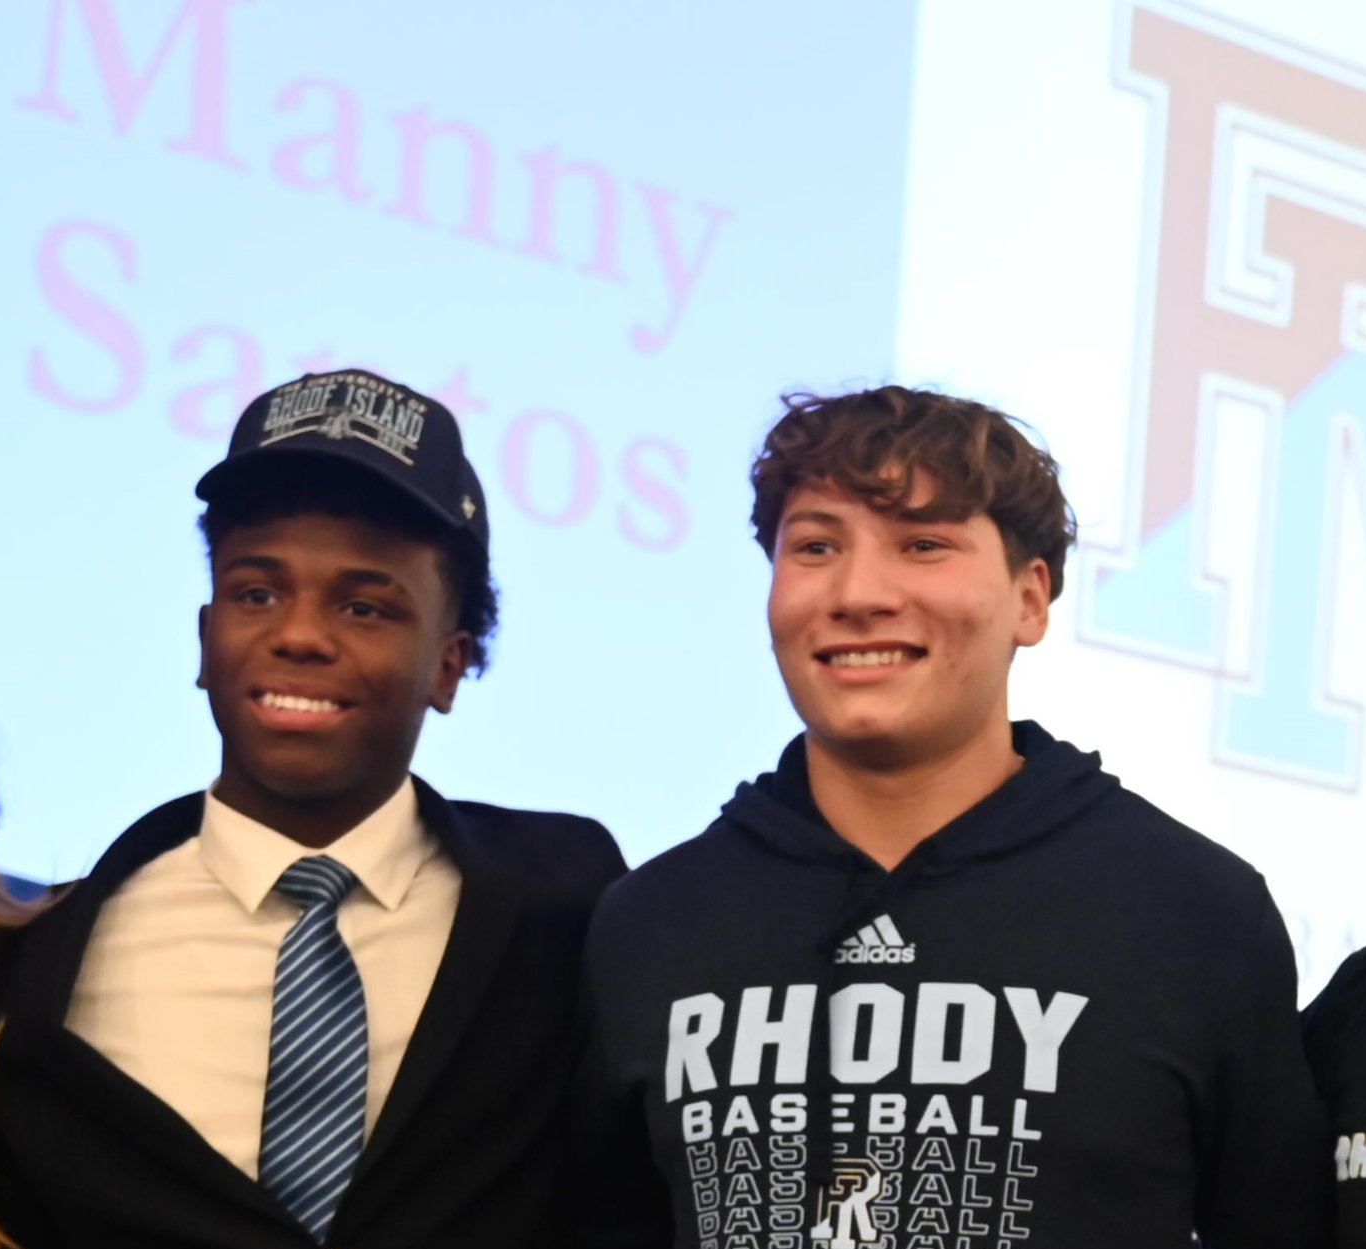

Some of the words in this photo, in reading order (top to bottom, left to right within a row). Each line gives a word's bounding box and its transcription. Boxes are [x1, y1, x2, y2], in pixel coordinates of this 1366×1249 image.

[15, 0, 735, 355] Manny
[25, 216, 691, 553] Saos
[263, 383, 338, 432] RHODE
[343, 383, 426, 444] ISLAND
[834, 942, 915, 964] adidas
[665, 982, 1090, 1103] RHODY
[682, 1093, 1042, 1144] BASEBALL
[686, 1135, 1038, 1177] BASBALL
